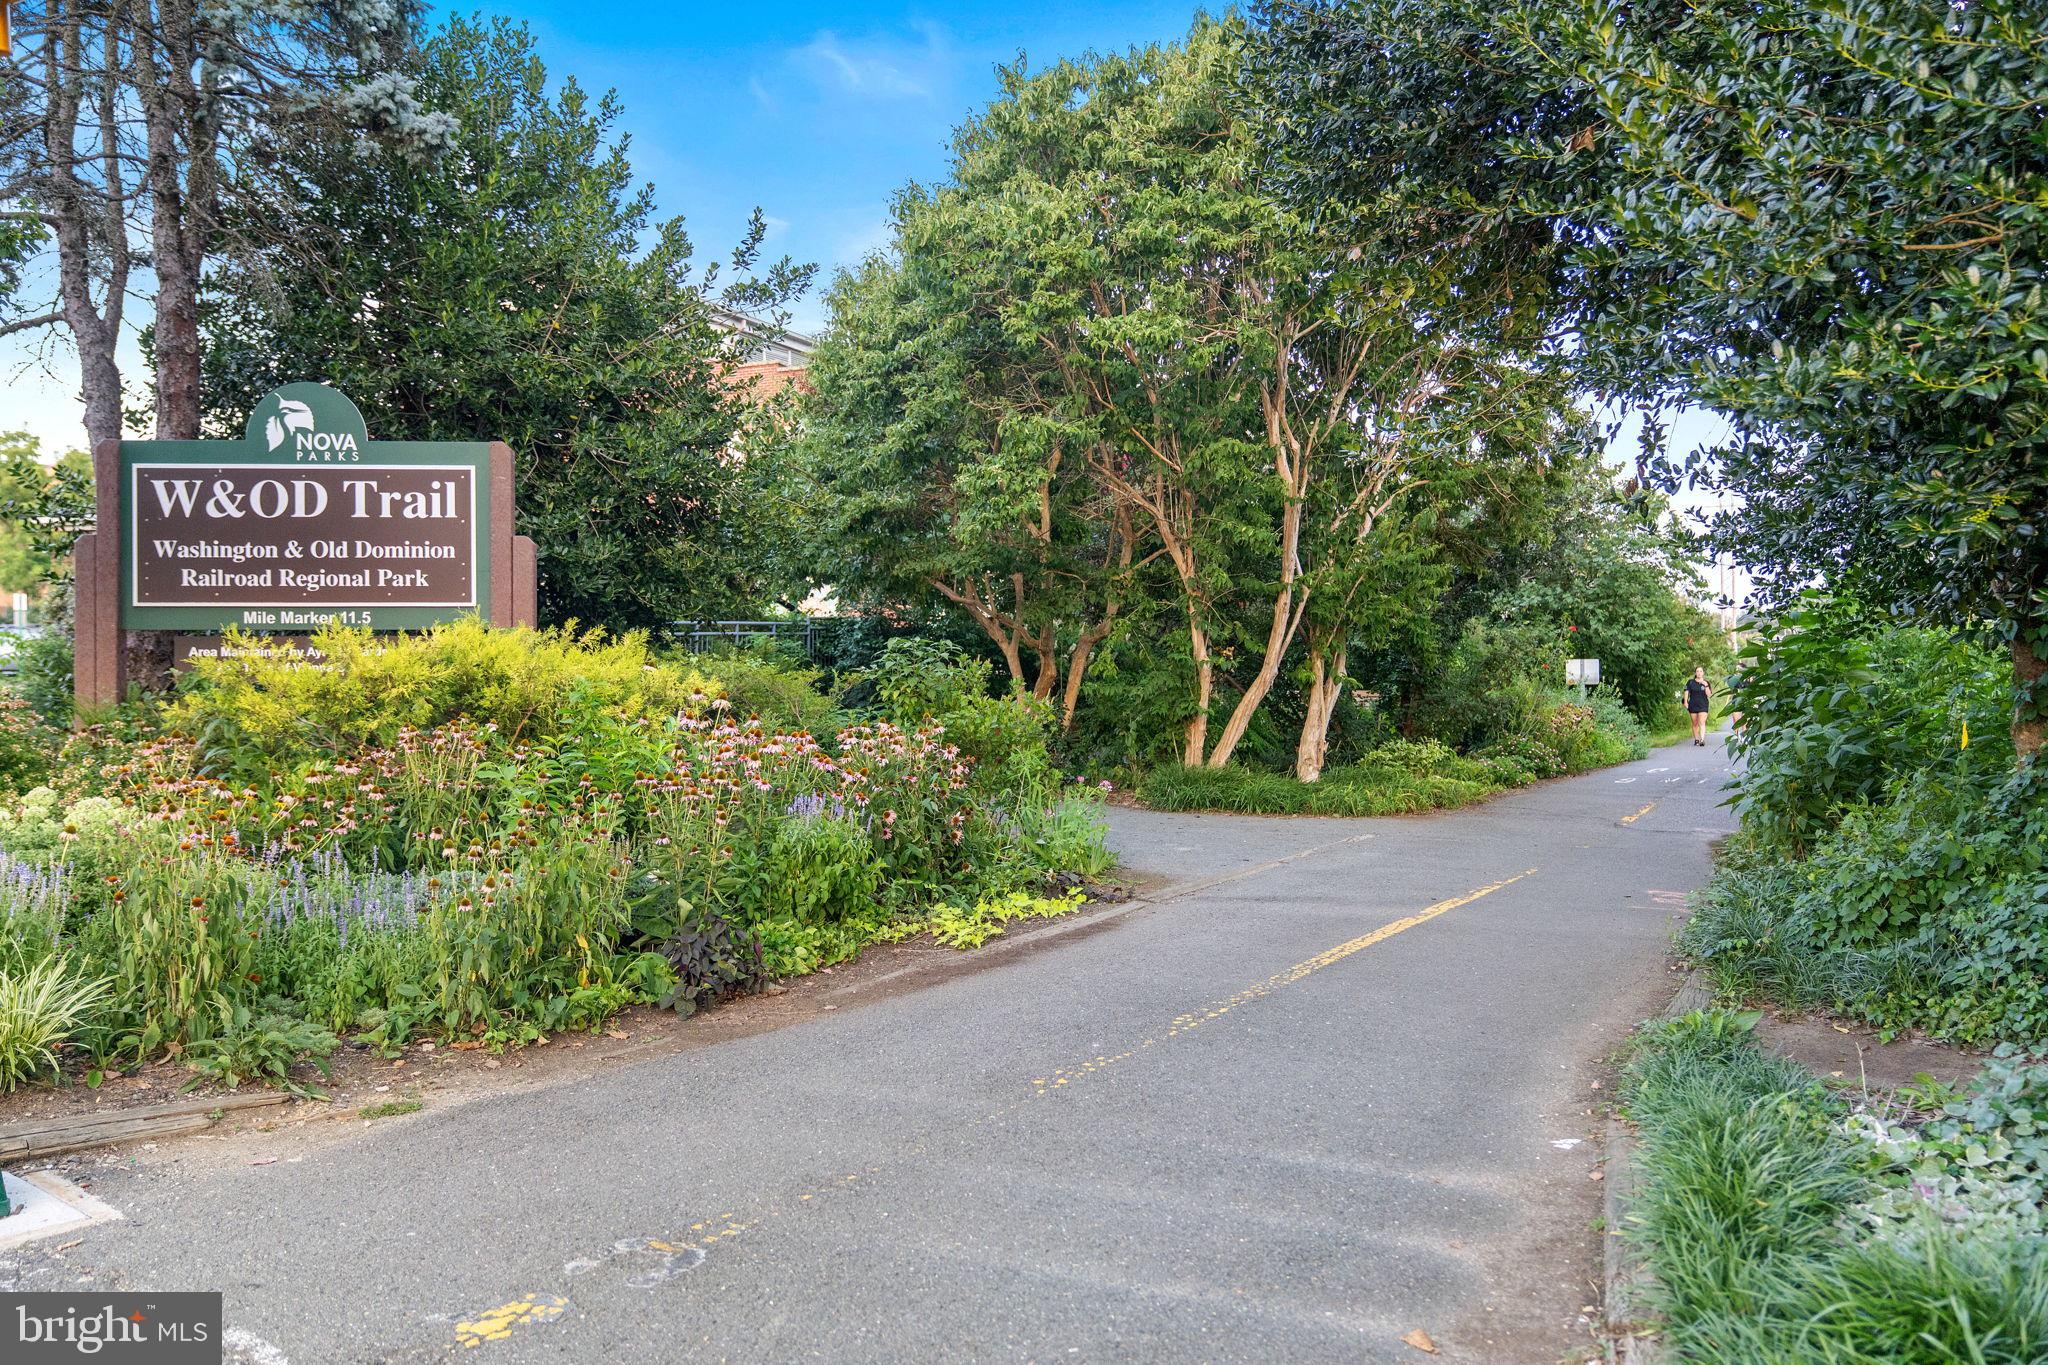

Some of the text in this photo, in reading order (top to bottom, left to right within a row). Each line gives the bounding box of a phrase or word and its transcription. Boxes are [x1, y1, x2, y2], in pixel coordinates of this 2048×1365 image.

[296, 432, 359, 451] NOVA
[296, 450, 360, 462] PARKS
[150, 479, 458, 519] W&OD Trail
[153, 539, 456, 563] Washington & Old Dominion
[181, 568, 430, 593] Railroad Regional Park
[243, 610, 372, 625] Mile Marker 11.5
[188, 646, 218, 658] Area
